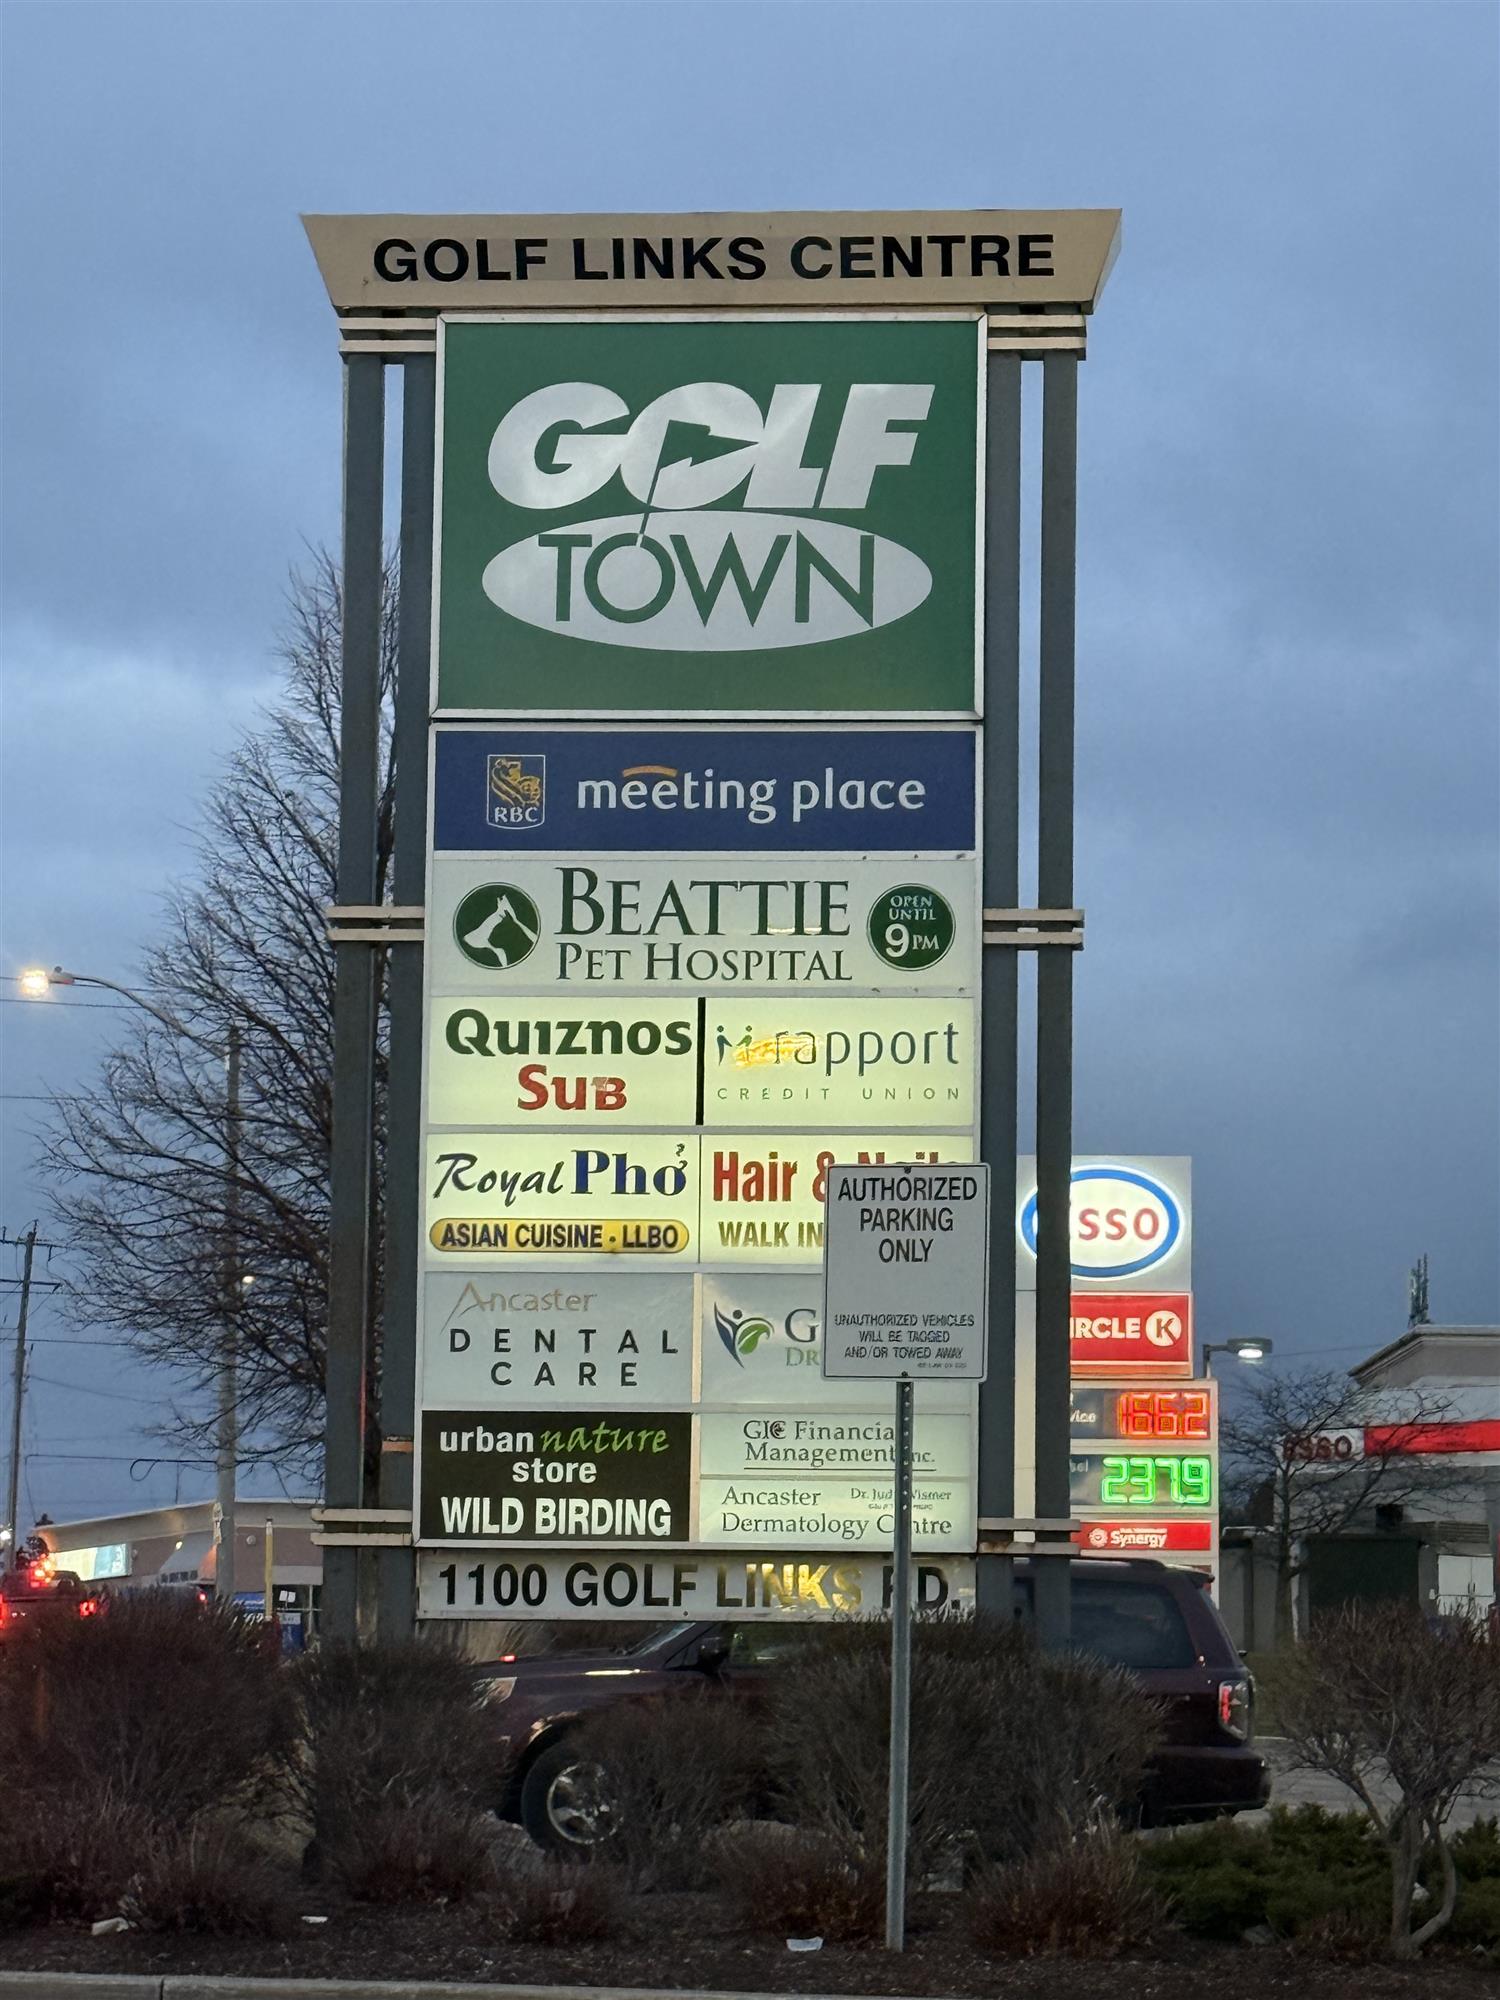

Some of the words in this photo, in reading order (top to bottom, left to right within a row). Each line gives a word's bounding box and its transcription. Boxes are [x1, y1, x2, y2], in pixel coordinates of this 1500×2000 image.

[373, 238, 548, 282] GOLF
[574, 237, 766, 280] LINKS
[790, 234, 1055, 278] CENTRE
[487, 382, 935, 510] GOLF
[537, 533, 874, 628] TOWN
[577, 767, 777, 824] meeting
[793, 767, 926, 822] place
[494, 806, 538, 823] RBC
[554, 867, 851, 936] BEATTIE
[888, 908, 937, 920] UNTIL
[890, 895, 933, 907] OPEN
[556, 943, 631, 980] PET
[646, 942, 852, 981] HOSPITAL
[774, 1023, 960, 1077] rapport
[717, 1088, 830, 1100] CREDIT
[862, 1088, 960, 1100] UNION
[434, 1152, 564, 1207] Royal
[713, 1151, 798, 1202] Hair
[837, 1176, 978, 1201] AUTHORIZED
[860, 1207, 954, 1232] PARKING
[1078, 1208, 1159, 1240] SSO
[440, 1223, 508, 1248] ASIAN
[515, 1223, 603, 1248] CUISINE
[622, 1224, 679, 1248] LLBO
[718, 1221, 790, 1247] WALK
[878, 1239, 934, 1263] ONLY
[440, 1280, 597, 1334] Ancaster
[834, 1314, 918, 1327] UNAUTHORIZED
[922, 1314, 975, 1327] VEHICLES
[1070, 1317, 1141, 1339] IRCLE
[450, 1328, 678, 1354] DENTAL
[859, 1330, 884, 1343] WILL
[888, 1330, 903, 1343] BE
[908, 1330, 950, 1343] TAGGED
[844, 1347, 889, 1359] AND/OR
[894, 1346, 932, 1359] TOWED
[490, 1361, 638, 1387] CARE
[440, 1426, 534, 1453] urban
[541, 1421, 670, 1454] nature
[795, 1420, 896, 1441] Financia
[744, 1442, 897, 1468] Management
[512, 1458, 597, 1484] store
[721, 1486, 822, 1506] Ancaster
[872, 1488, 894, 1500] Jud
[441, 1497, 525, 1535] WILD
[535, 1498, 672, 1537] BIRDING
[722, 1513, 869, 1540] Dermatology
[877, 1512, 953, 1534] Cntre
[1110, 1530, 1168, 1549] Synergy
[438, 1563, 549, 1606] 1100
[564, 1563, 698, 1607] GOLF
[716, 1562, 863, 1611] LINKS
